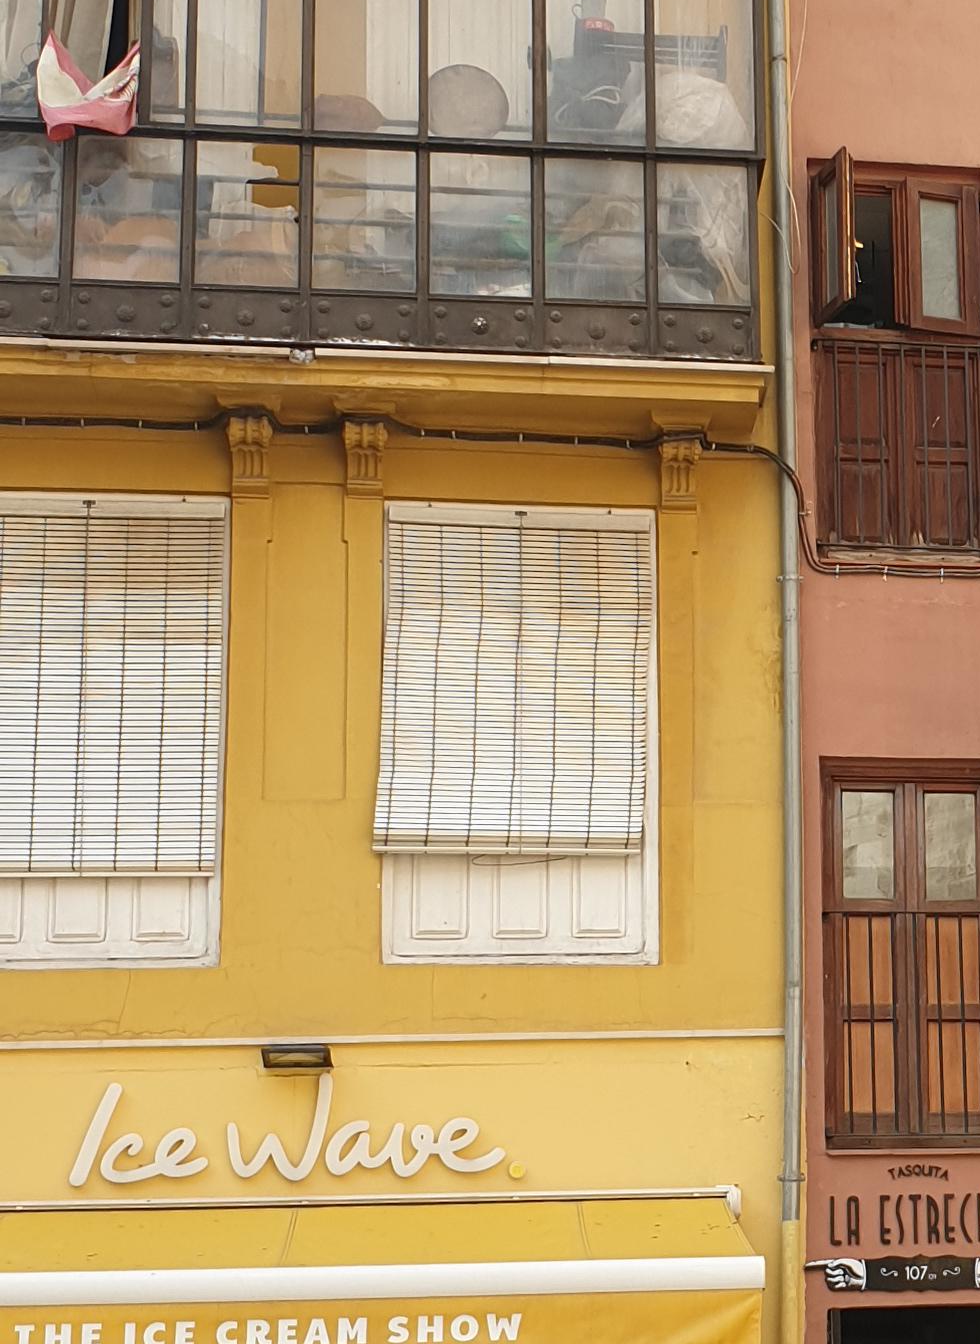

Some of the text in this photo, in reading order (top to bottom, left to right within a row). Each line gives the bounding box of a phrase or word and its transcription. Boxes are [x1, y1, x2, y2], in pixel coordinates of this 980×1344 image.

[68, 1082, 208, 1188] Ice
[888, 1164, 949, 1182] TASQUITA
[829, 1195, 860, 1246] LA
[904, 1265, 928, 1281] 107
[387, 1312, 523, 1344] SHOW
